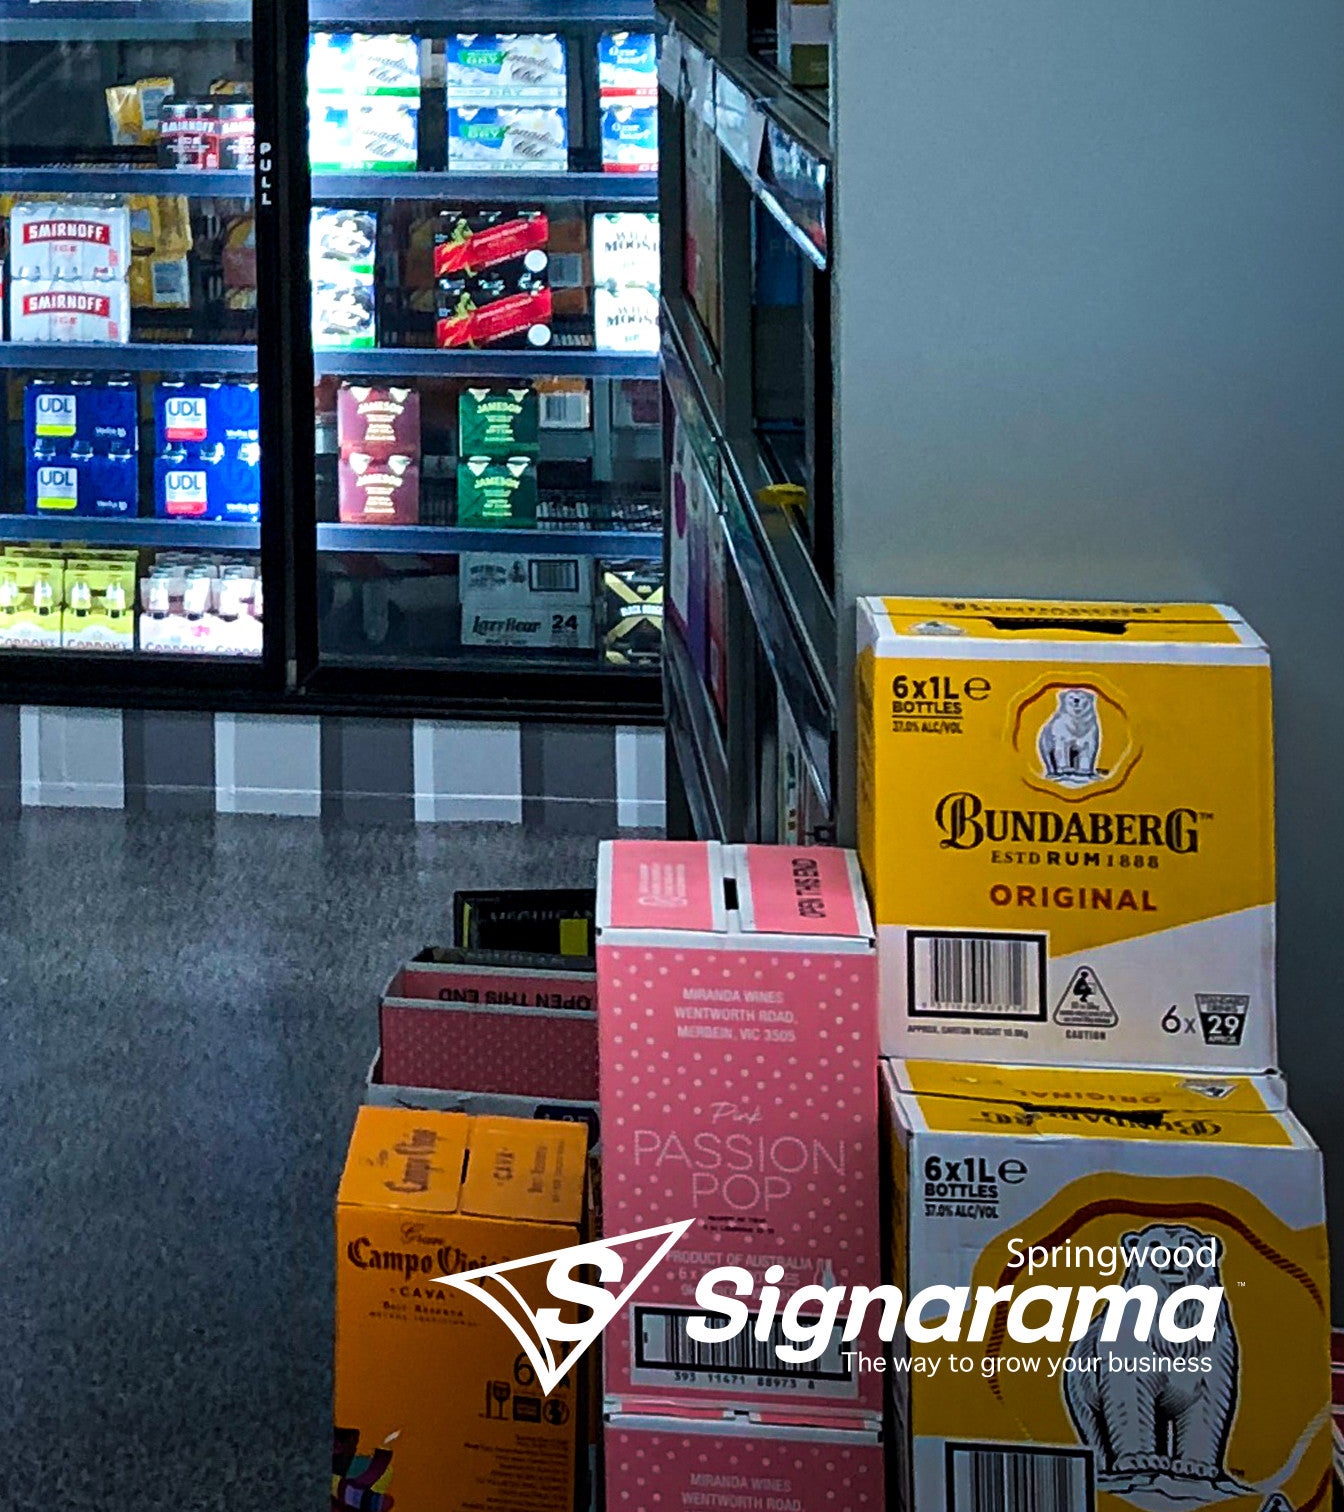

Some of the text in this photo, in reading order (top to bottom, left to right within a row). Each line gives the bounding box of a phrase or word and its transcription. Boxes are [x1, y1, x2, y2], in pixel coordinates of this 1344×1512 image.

[259, 142, 272, 205] PULL
[29, 223, 103, 240] SMIRNOFF
[29, 295, 103, 311] SMIRNOFF
[39, 398, 72, 413] UDL
[168, 401, 201, 416] UDL
[40, 470, 73, 486] UDL
[168, 475, 201, 490] UDL
[552, 615, 578, 630] 24
[892, 701, 962, 714] BOTTLES
[991, 851, 1159, 869] ESTD RUM 1888
[990, 884, 1158, 911] ORIGINAL
[438, 988, 479, 1003] END
[536, 993, 592, 1011] OPEN
[683, 988, 785, 1005] MIRANDA WINES
[674, 1006, 755, 1021] WENTWORTH
[1208, 1014, 1240, 1035] 29
[1066, 1029, 1106, 1040] CAUTION
[633, 1129, 846, 1176] PASSION
[692, 1172, 792, 1211] POP
[925, 1183, 999, 1198] BOTTLES
[955, 1204, 999, 1219] ALC/VOL
[347, 1236, 433, 1281] Campo
[665, 1249, 813, 1269] PRODUCT OF AUSTRALIA
[400, 1286, 446, 1301] CAVA
[691, 1472, 792, 1491] MIRANDA WINES
[682, 1491, 763, 1509] WENTWORTH
